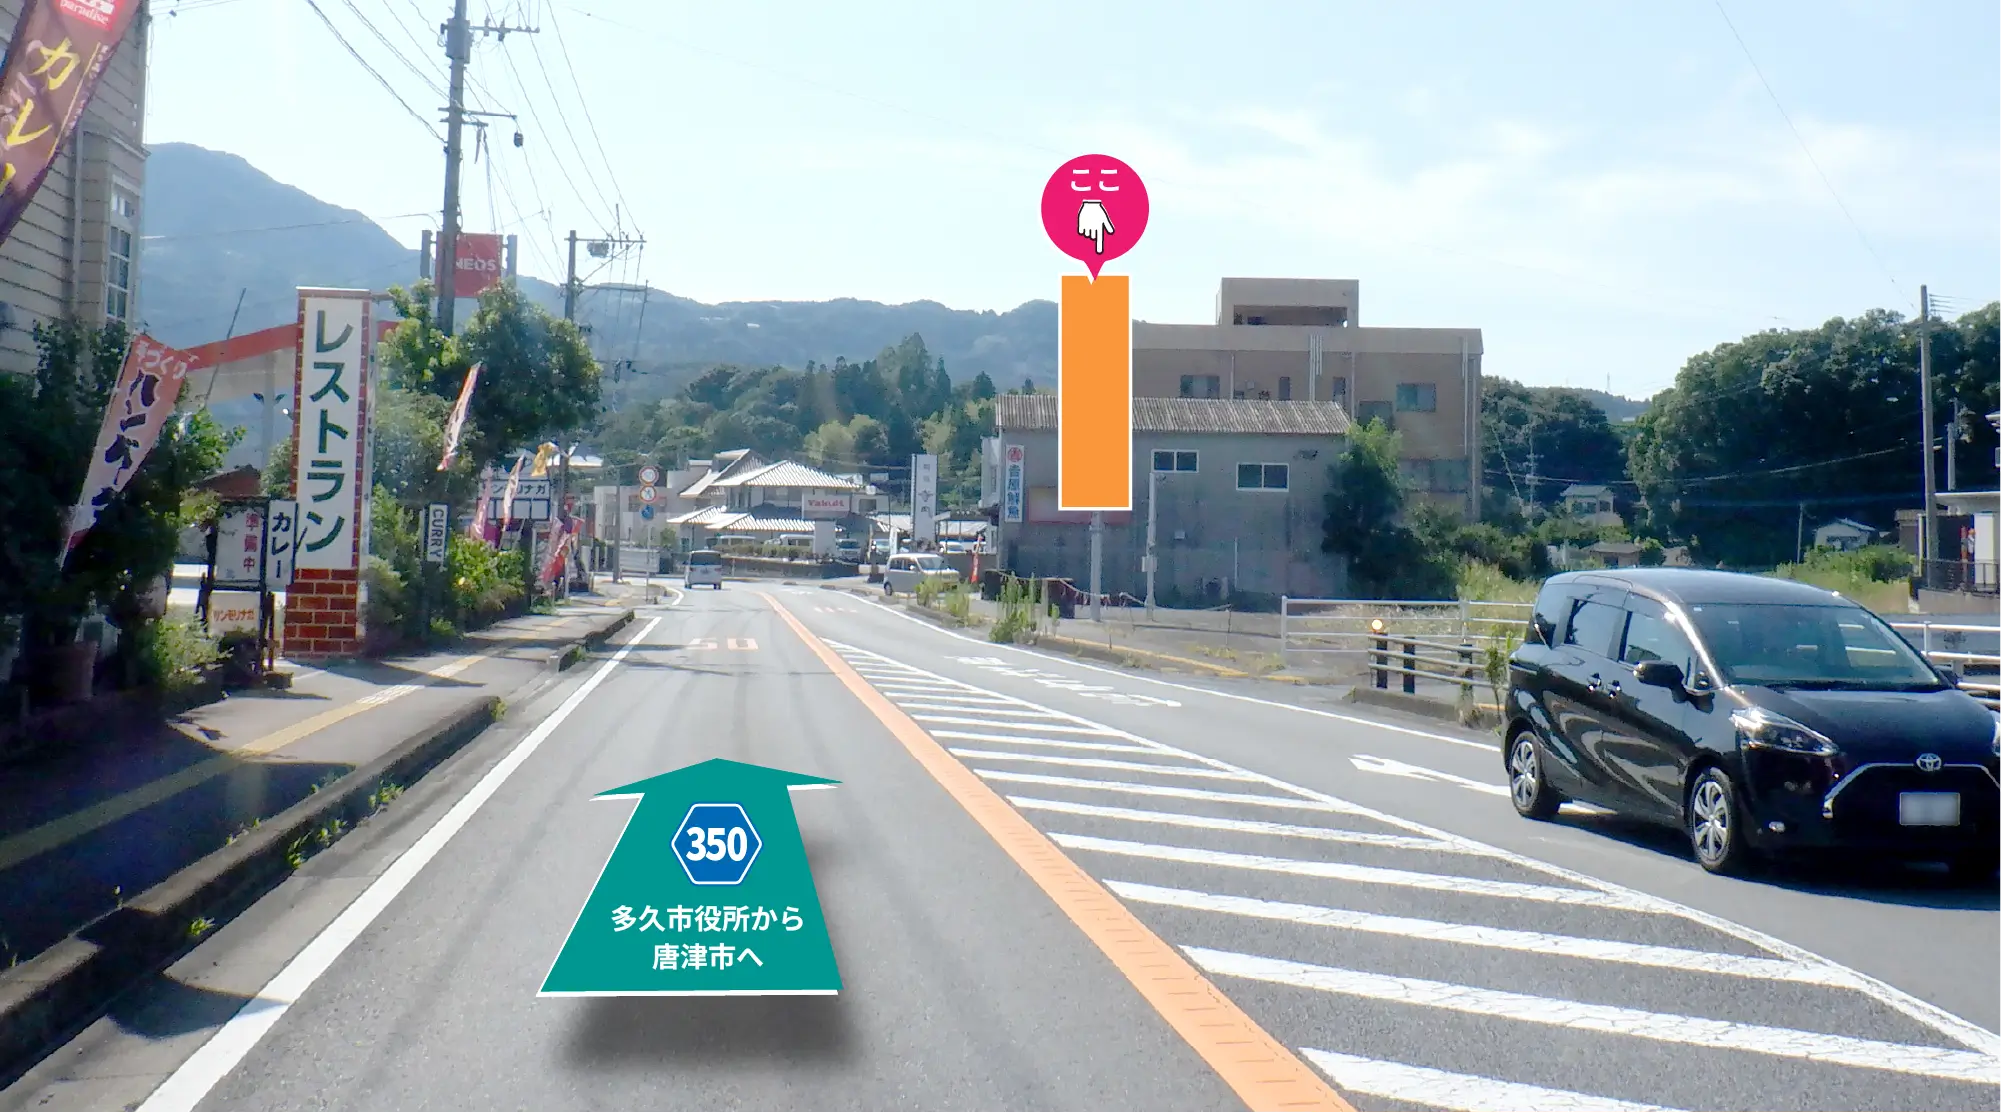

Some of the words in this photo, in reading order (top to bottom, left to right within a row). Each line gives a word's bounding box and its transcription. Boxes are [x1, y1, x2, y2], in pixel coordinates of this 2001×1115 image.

[456, 258, 497, 271] NEOS
[306, 309, 354, 553] レストラン
[271, 512, 291, 578] カレー
[429, 508, 444, 558] CURRY
